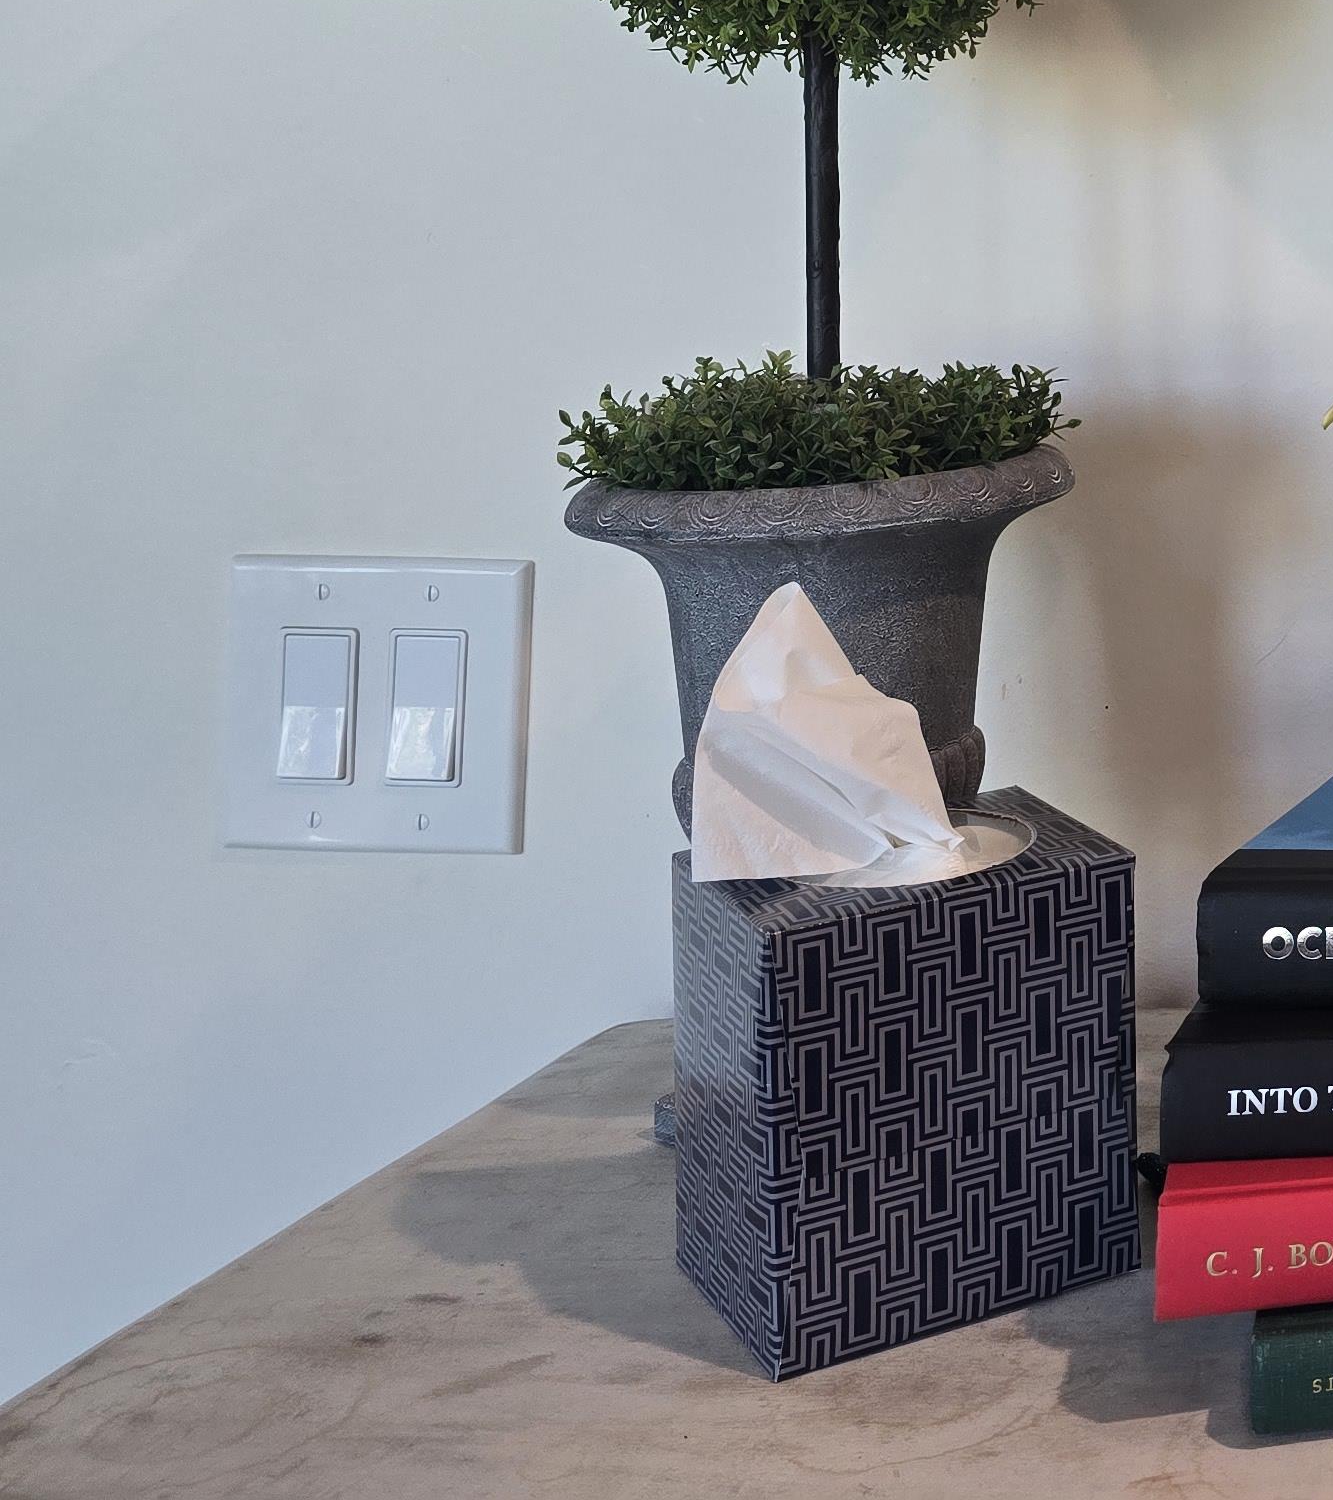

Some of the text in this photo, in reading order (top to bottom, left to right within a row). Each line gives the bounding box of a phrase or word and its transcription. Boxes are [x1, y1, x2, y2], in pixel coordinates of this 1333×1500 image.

[1227, 1086, 1318, 1116] INTO
[1206, 1251, 1238, 1278] C.
[1252, 1247, 1274, 1279] J.
